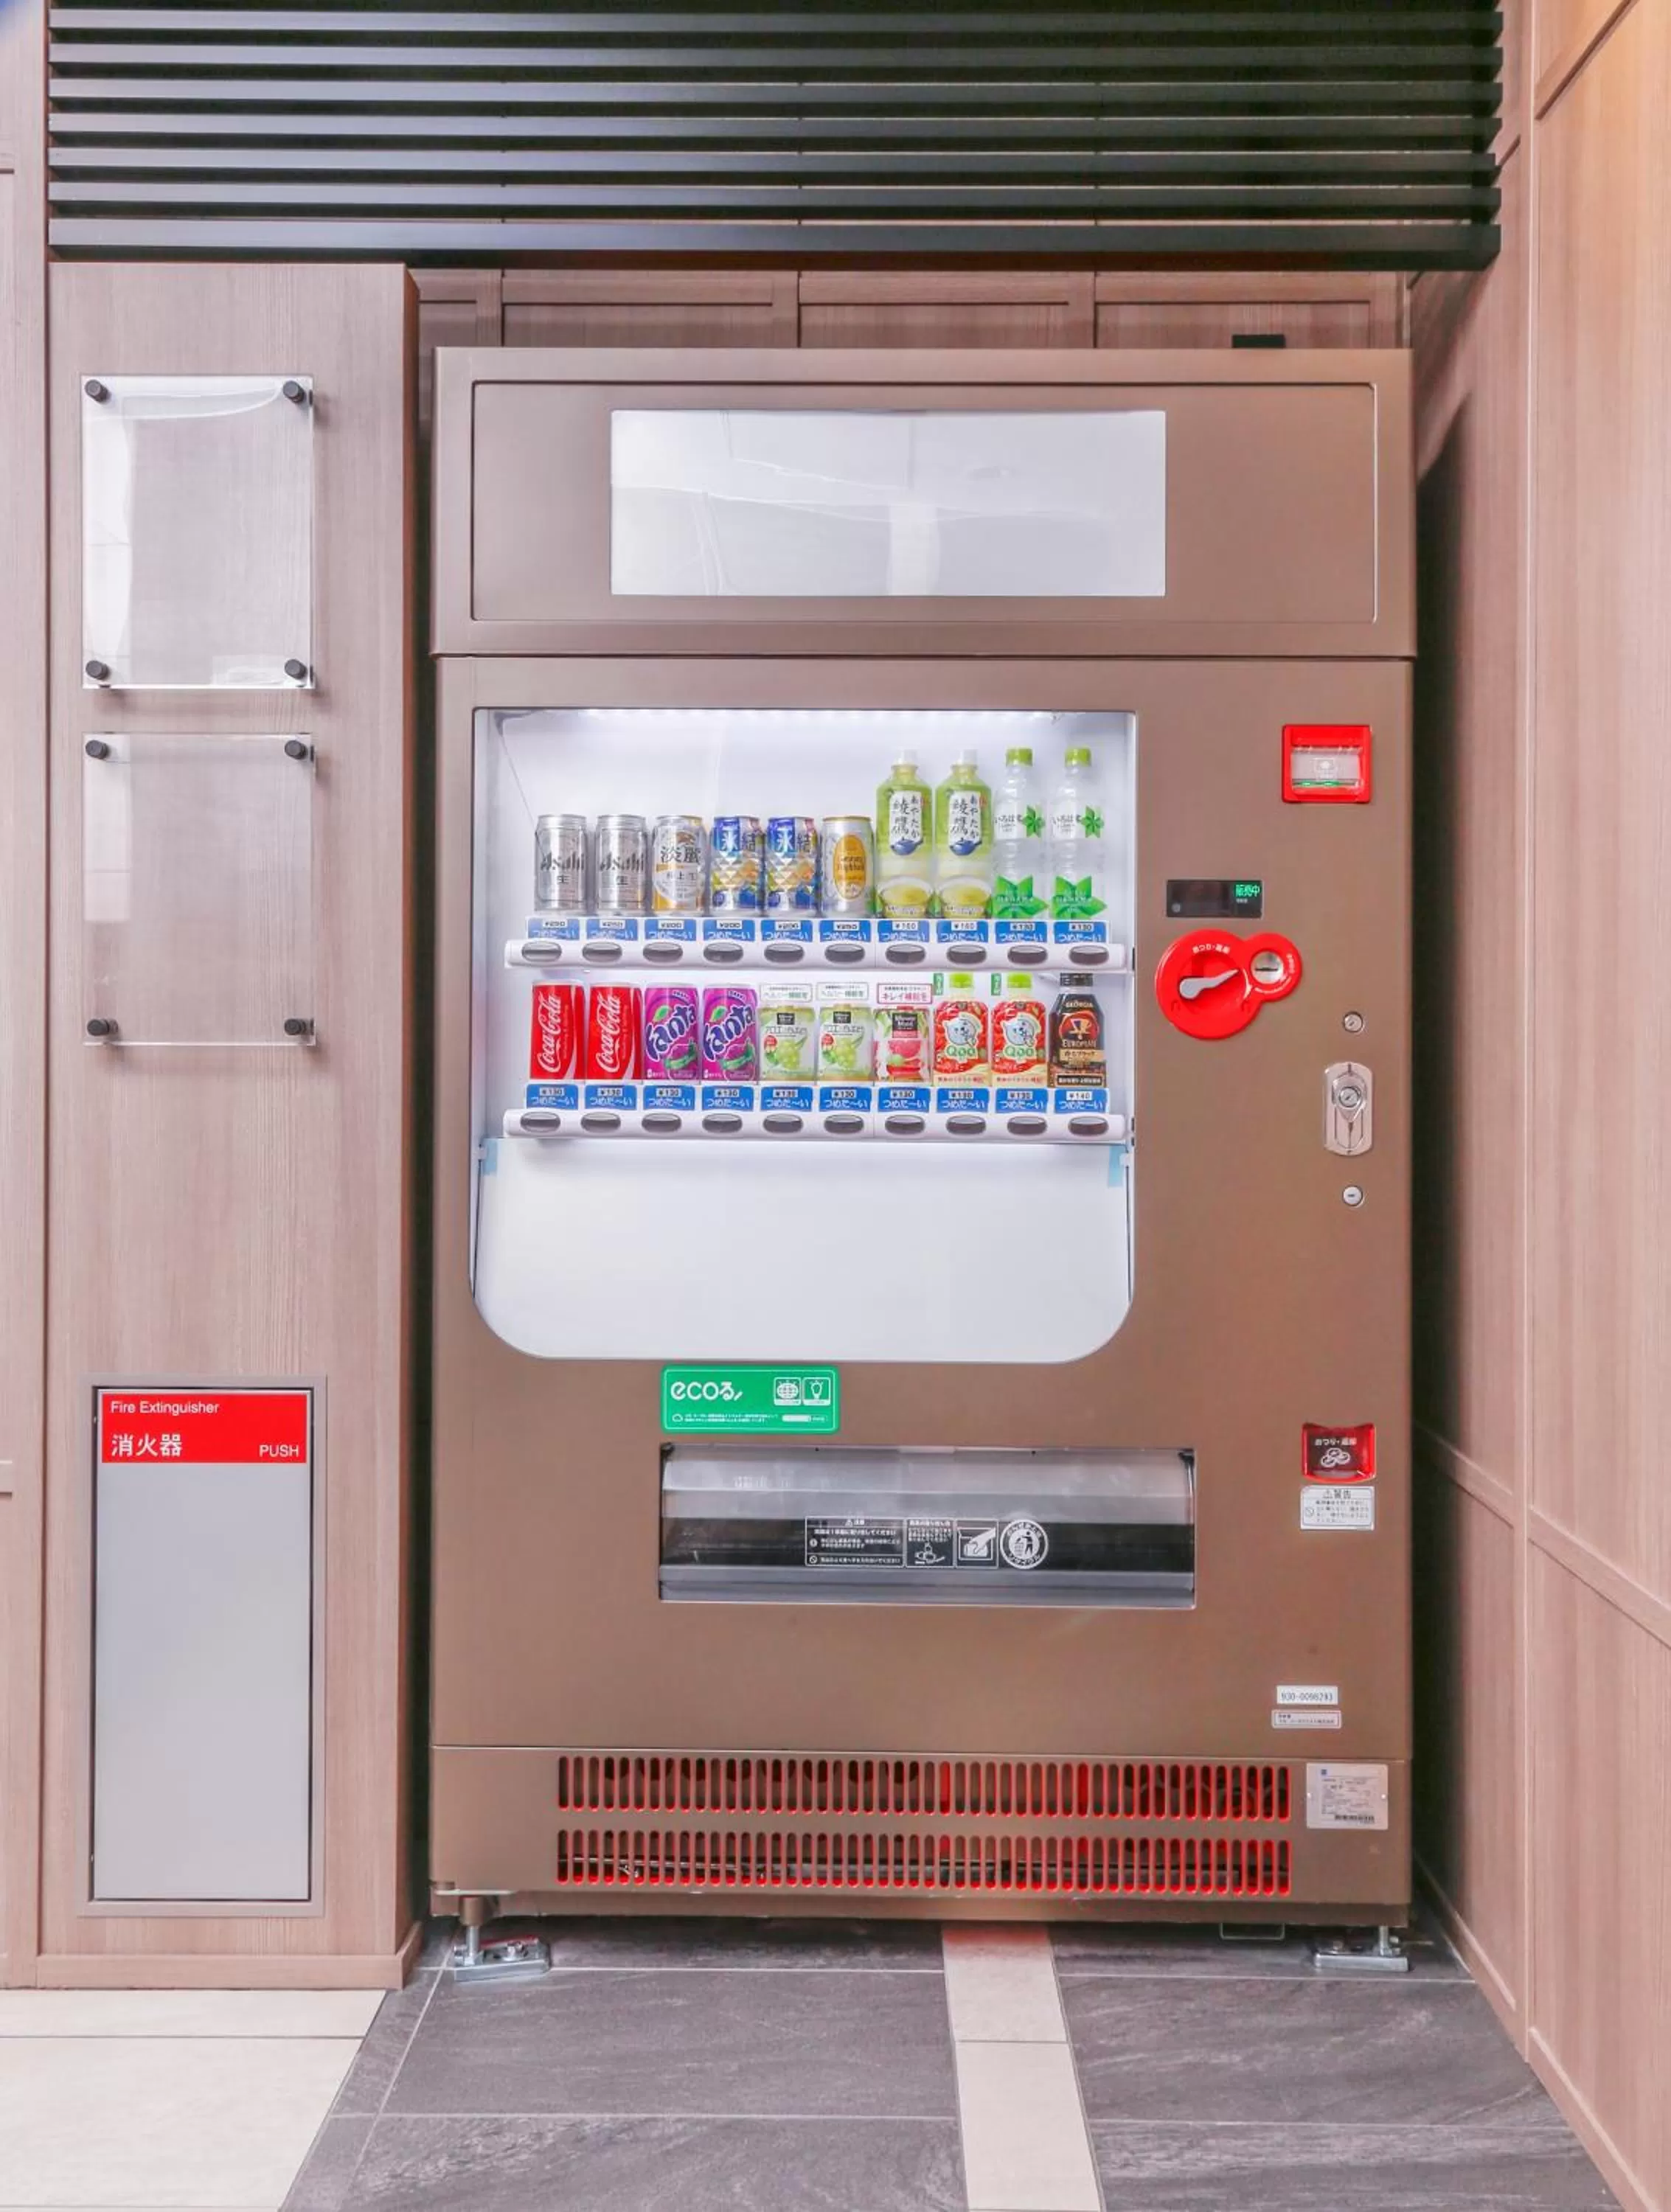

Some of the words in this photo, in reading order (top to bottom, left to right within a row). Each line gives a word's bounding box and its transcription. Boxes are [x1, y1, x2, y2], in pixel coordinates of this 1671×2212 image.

[541, 850, 584, 871] Asahi
[600, 851, 645, 872] Asahi
[646, 1004, 696, 1062] Fanta
[704, 1004, 754, 1062] Fanta
[946, 1044, 976, 1057] Qoo
[1004, 1045, 1035, 1057] Qoo
[110, 1401, 136, 1413] Fire
[139, 1400, 218, 1416] Extinguisher
[111, 1433, 183, 1457] 消火器
[259, 1444, 299, 1458] PUSH
